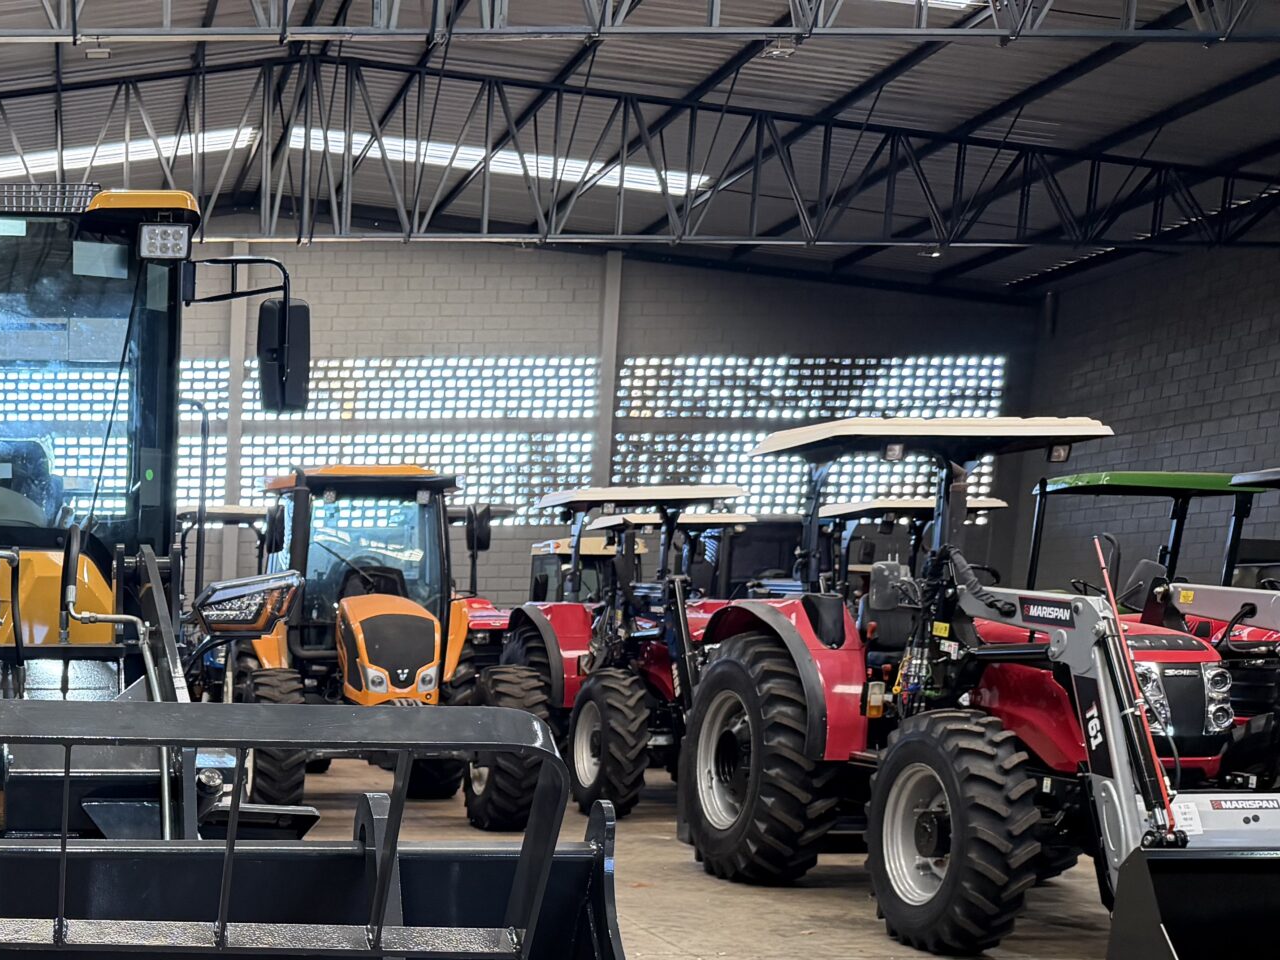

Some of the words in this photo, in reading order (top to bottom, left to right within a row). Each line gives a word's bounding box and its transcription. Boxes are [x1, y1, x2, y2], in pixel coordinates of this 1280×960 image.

[1030, 605, 1070, 620] MARISPAN
[1086, 701, 1103, 750] T61
[1221, 800, 1278, 809] MARISPAN
